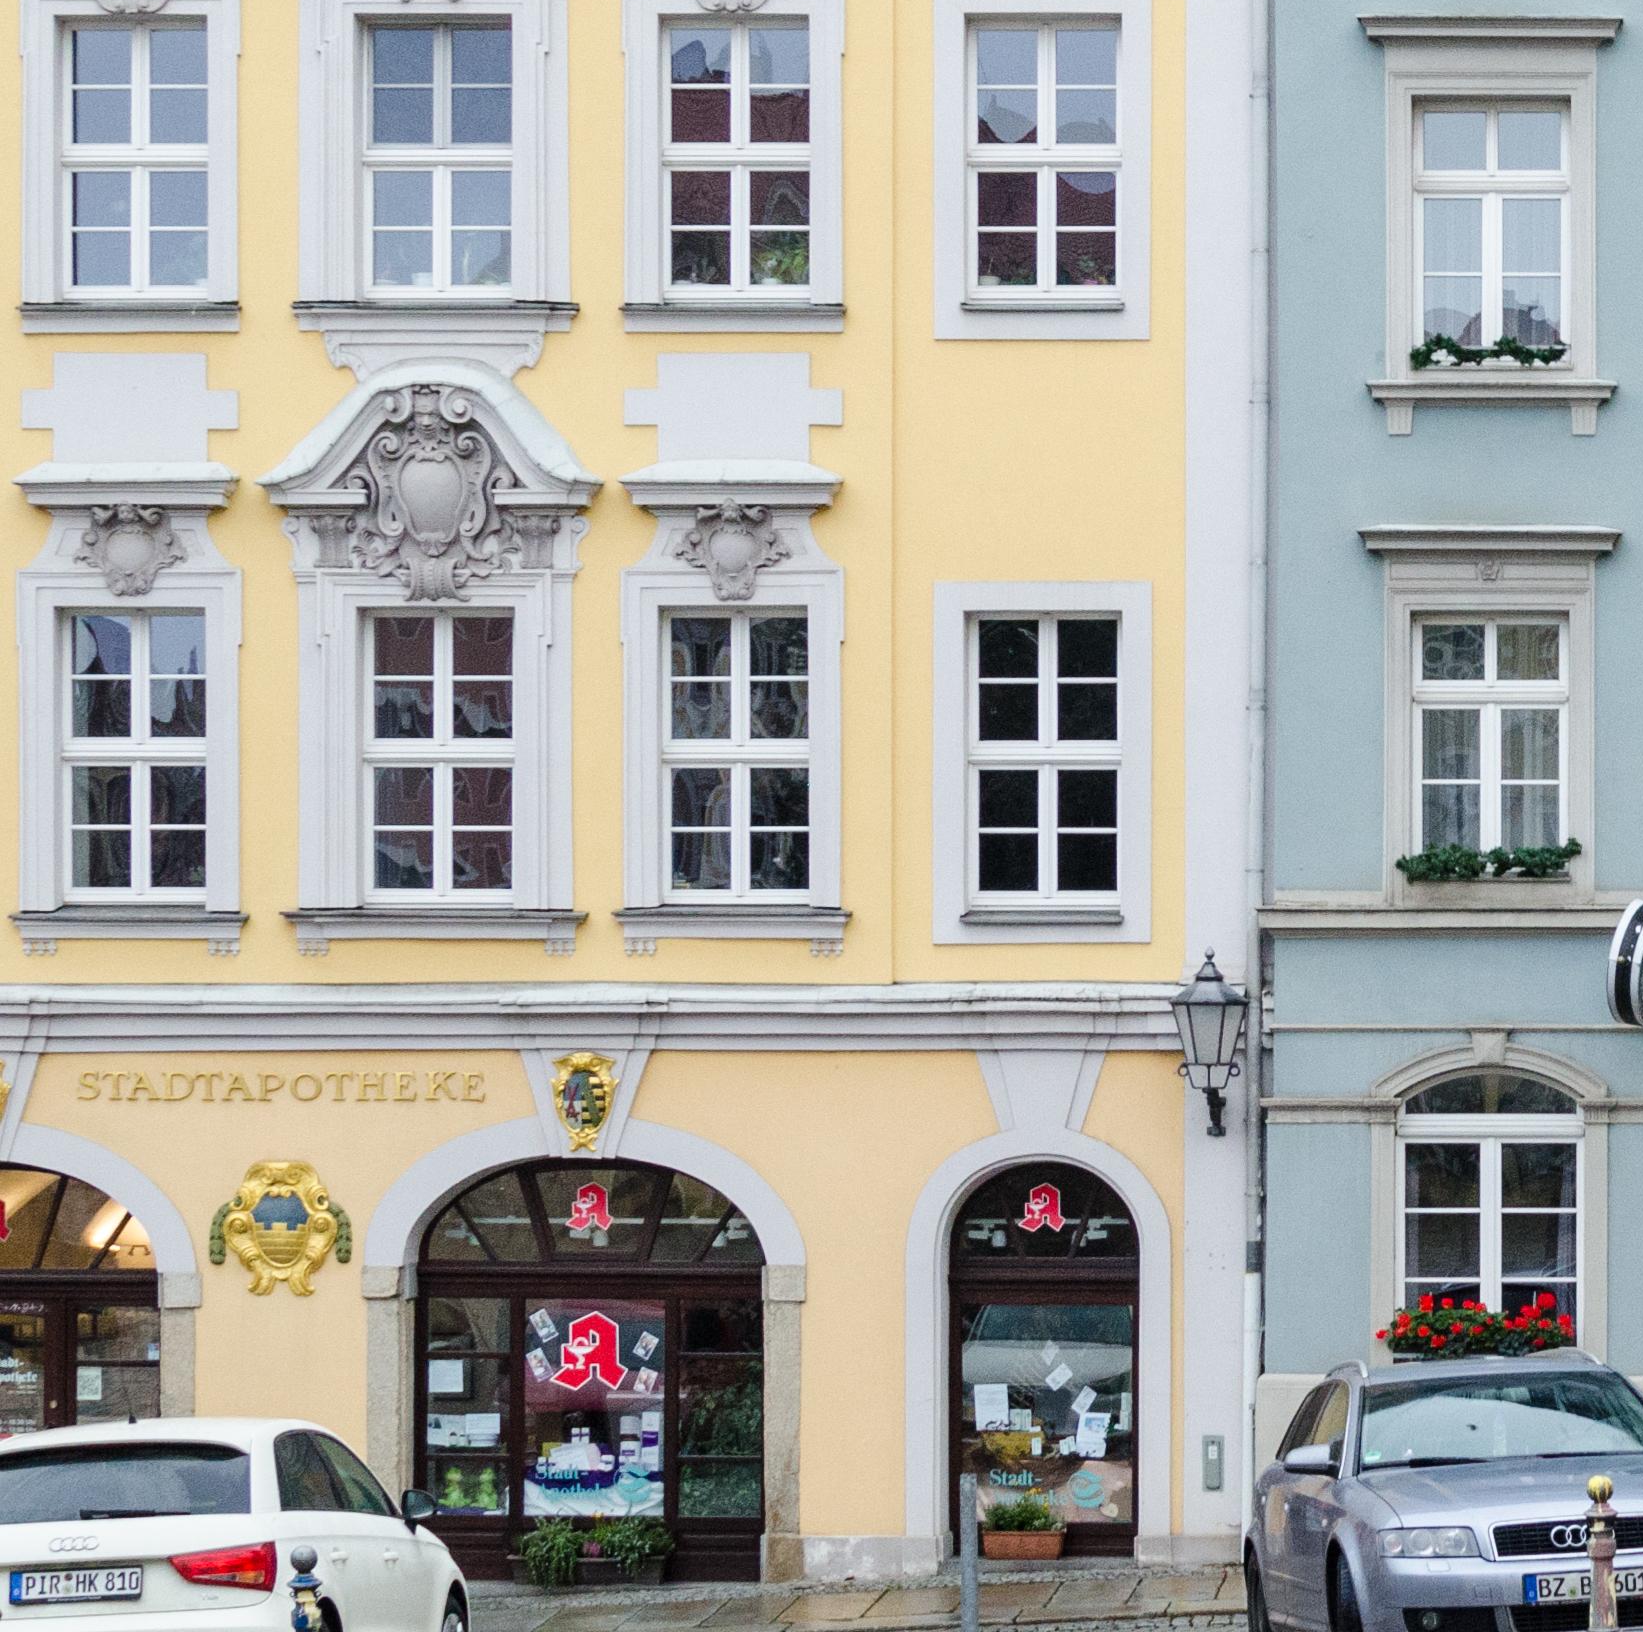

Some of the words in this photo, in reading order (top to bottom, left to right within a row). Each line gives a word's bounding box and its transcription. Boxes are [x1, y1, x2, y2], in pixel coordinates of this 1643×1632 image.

[77, 1071, 486, 1103] STADTAPOTHEKE
[25, 1574, 61, 1596] PIR
[75, 1572, 99, 1594] HK
[105, 1570, 140, 1591] 810
[1538, 1577, 1566, 1598] BZ
